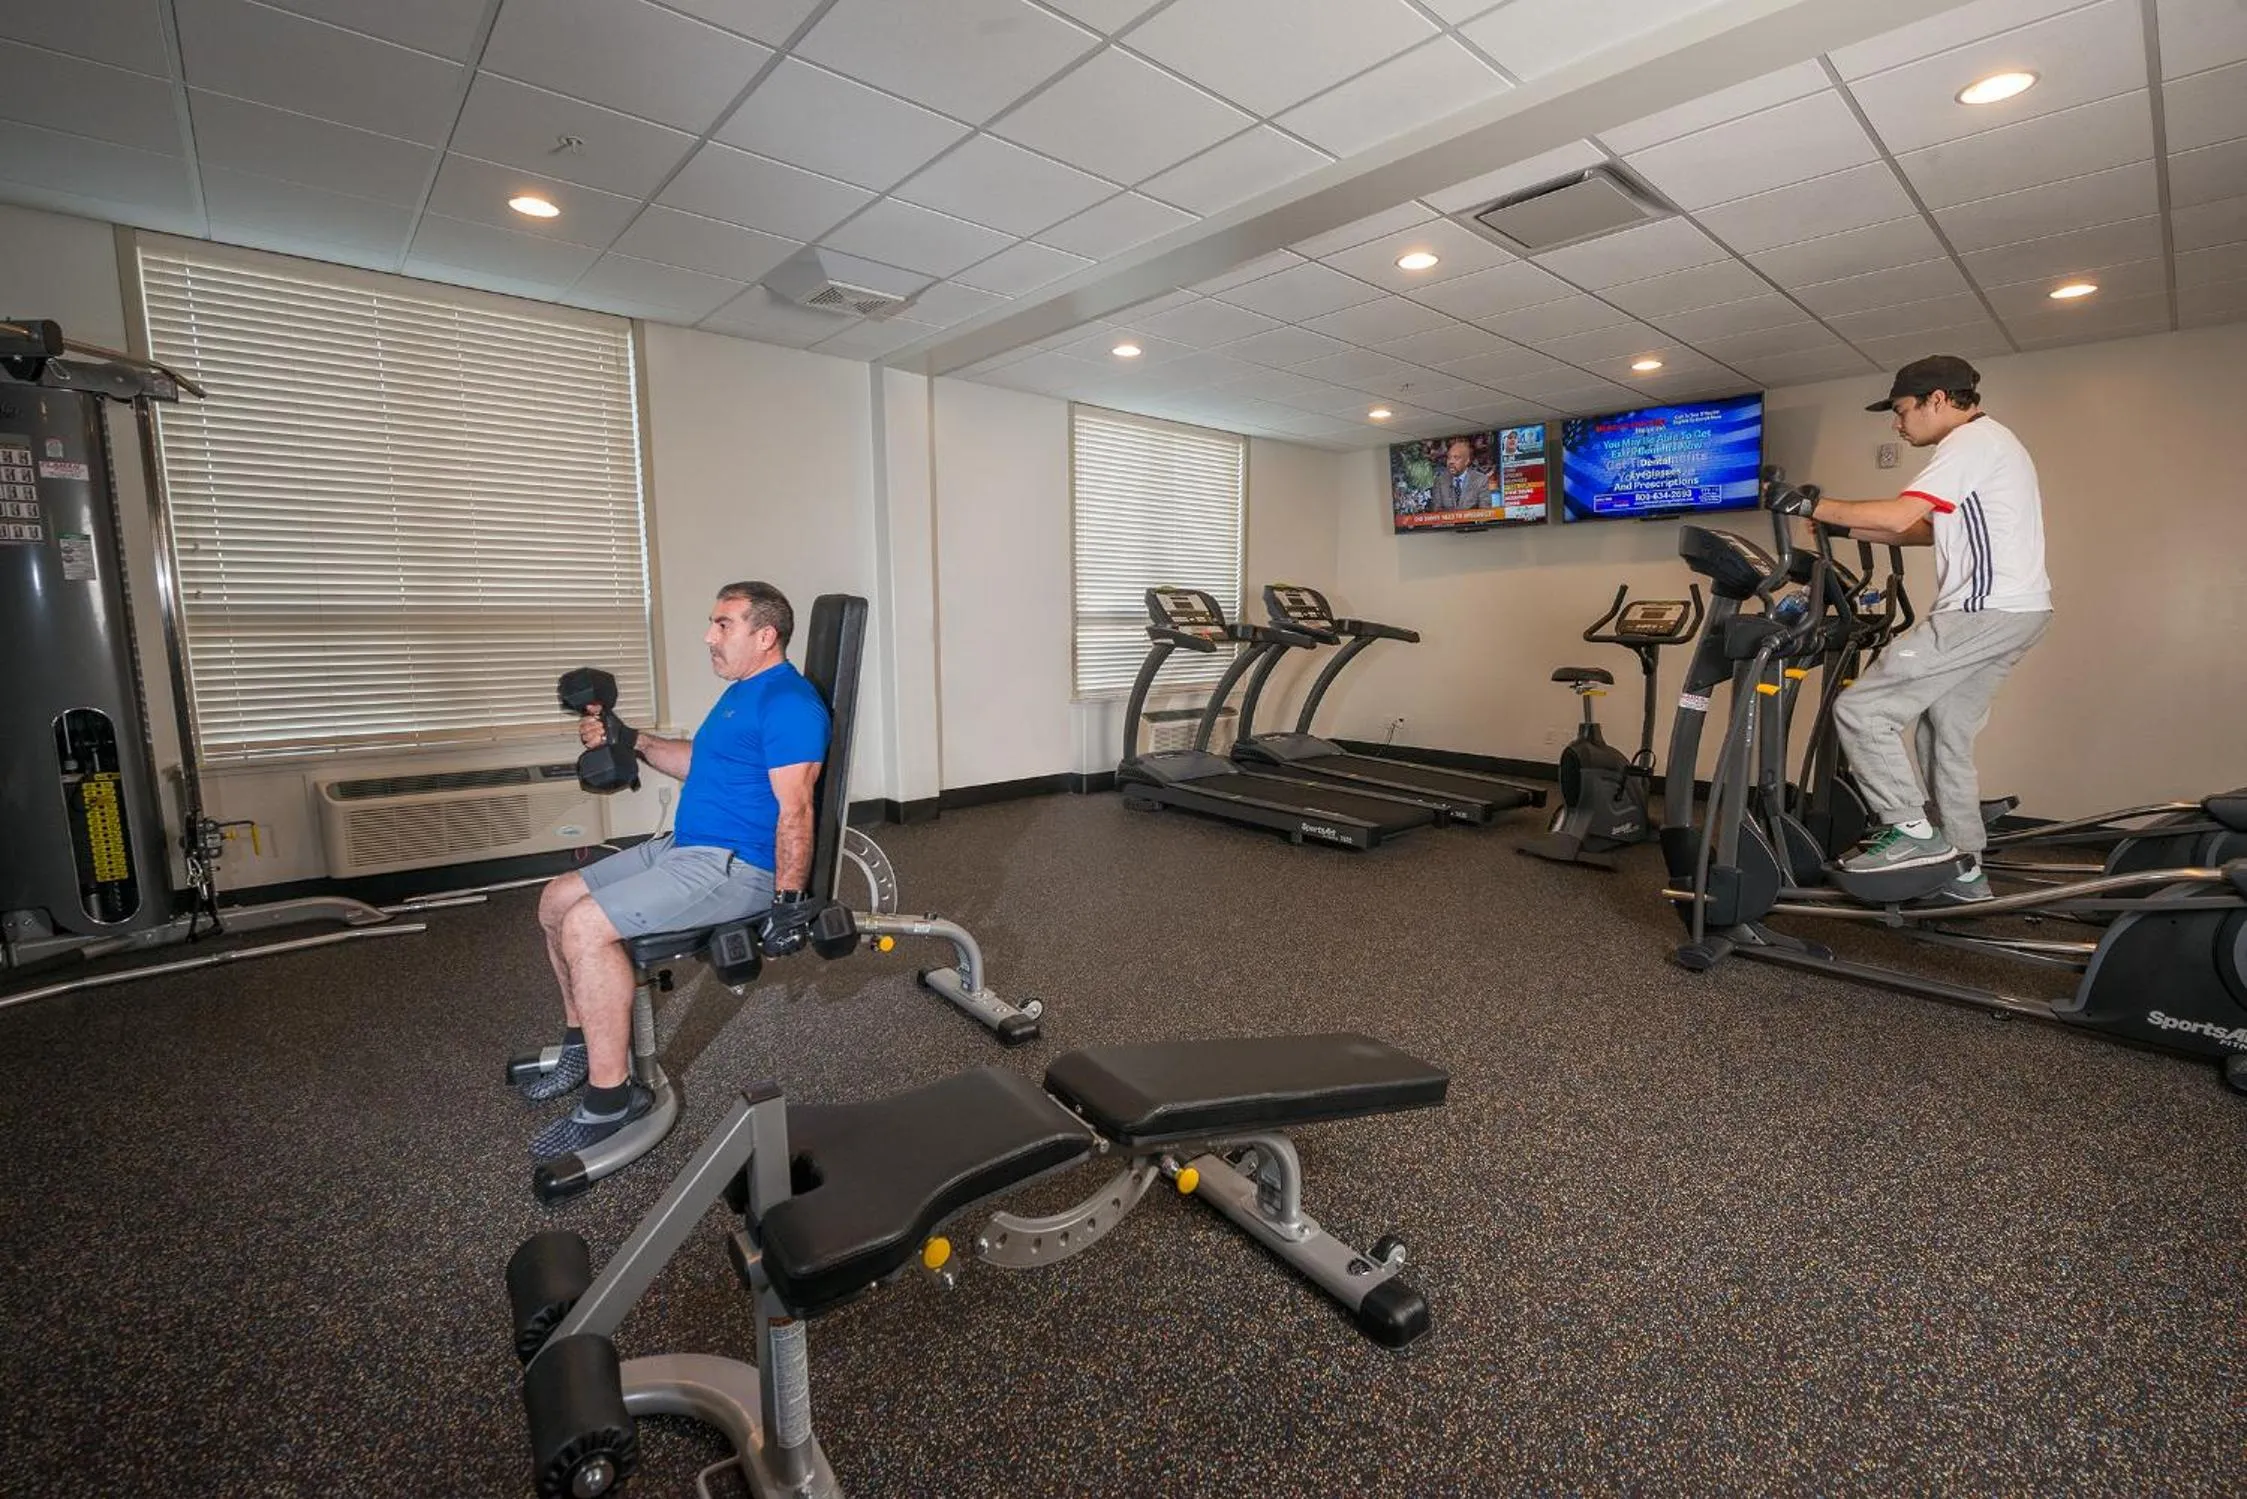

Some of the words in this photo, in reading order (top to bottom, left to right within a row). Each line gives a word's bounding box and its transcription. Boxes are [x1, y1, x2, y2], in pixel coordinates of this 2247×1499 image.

[1613, 481, 1633, 491] And
[1633, 477, 1699, 490] Prescriptions
[2147, 1010, 2247, 1043] SportsA
